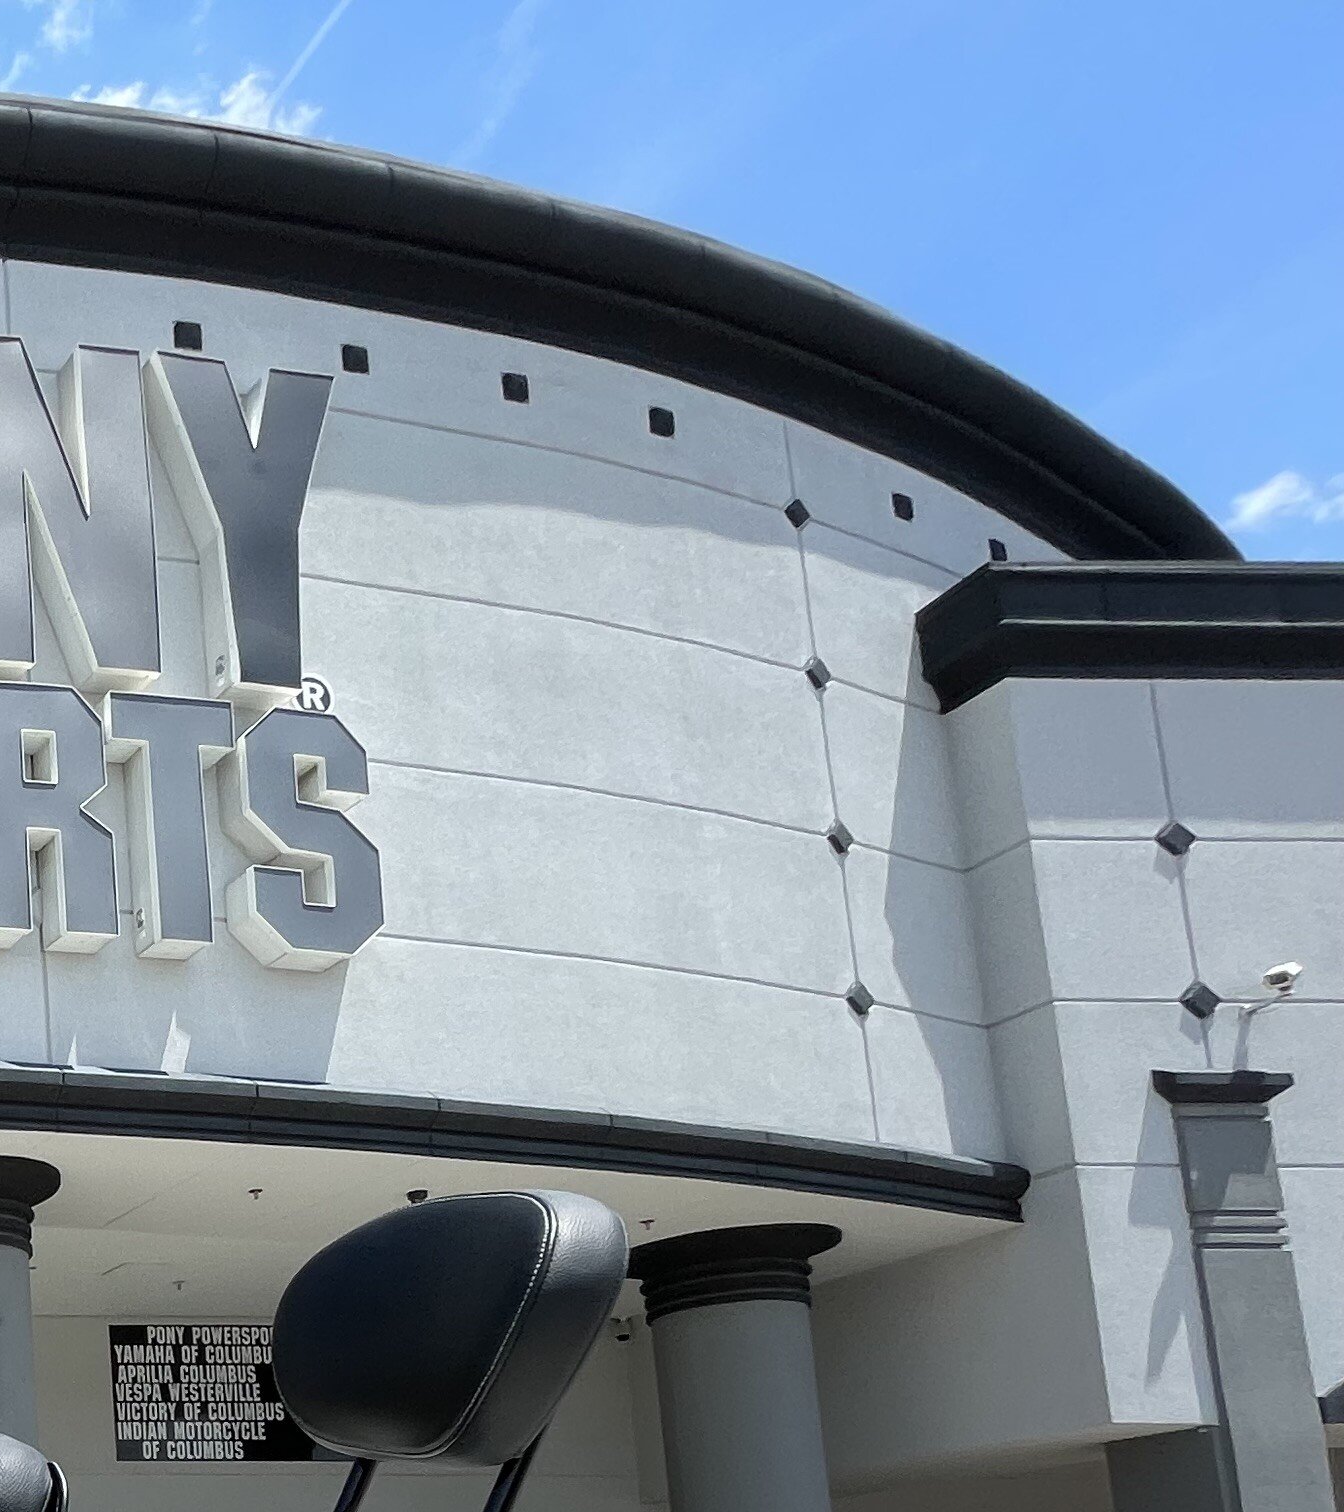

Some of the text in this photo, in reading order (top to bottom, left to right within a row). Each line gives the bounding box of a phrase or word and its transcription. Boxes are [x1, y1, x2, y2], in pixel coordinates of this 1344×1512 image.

[146, 1326, 185, 1345] PONY
[114, 1345, 273, 1364] YAMAHA OF COLUMBU
[117, 1365, 257, 1383] APRILIA COLUMBUS
[115, 1383, 261, 1402] VESPA WESTERVILLE
[116, 1402, 285, 1421] VICTORY OF COLUMBUS
[116, 1421, 267, 1440] INDIAN MOTORCYCLE
[142, 1441, 244, 1460] OF COLUMBUS
